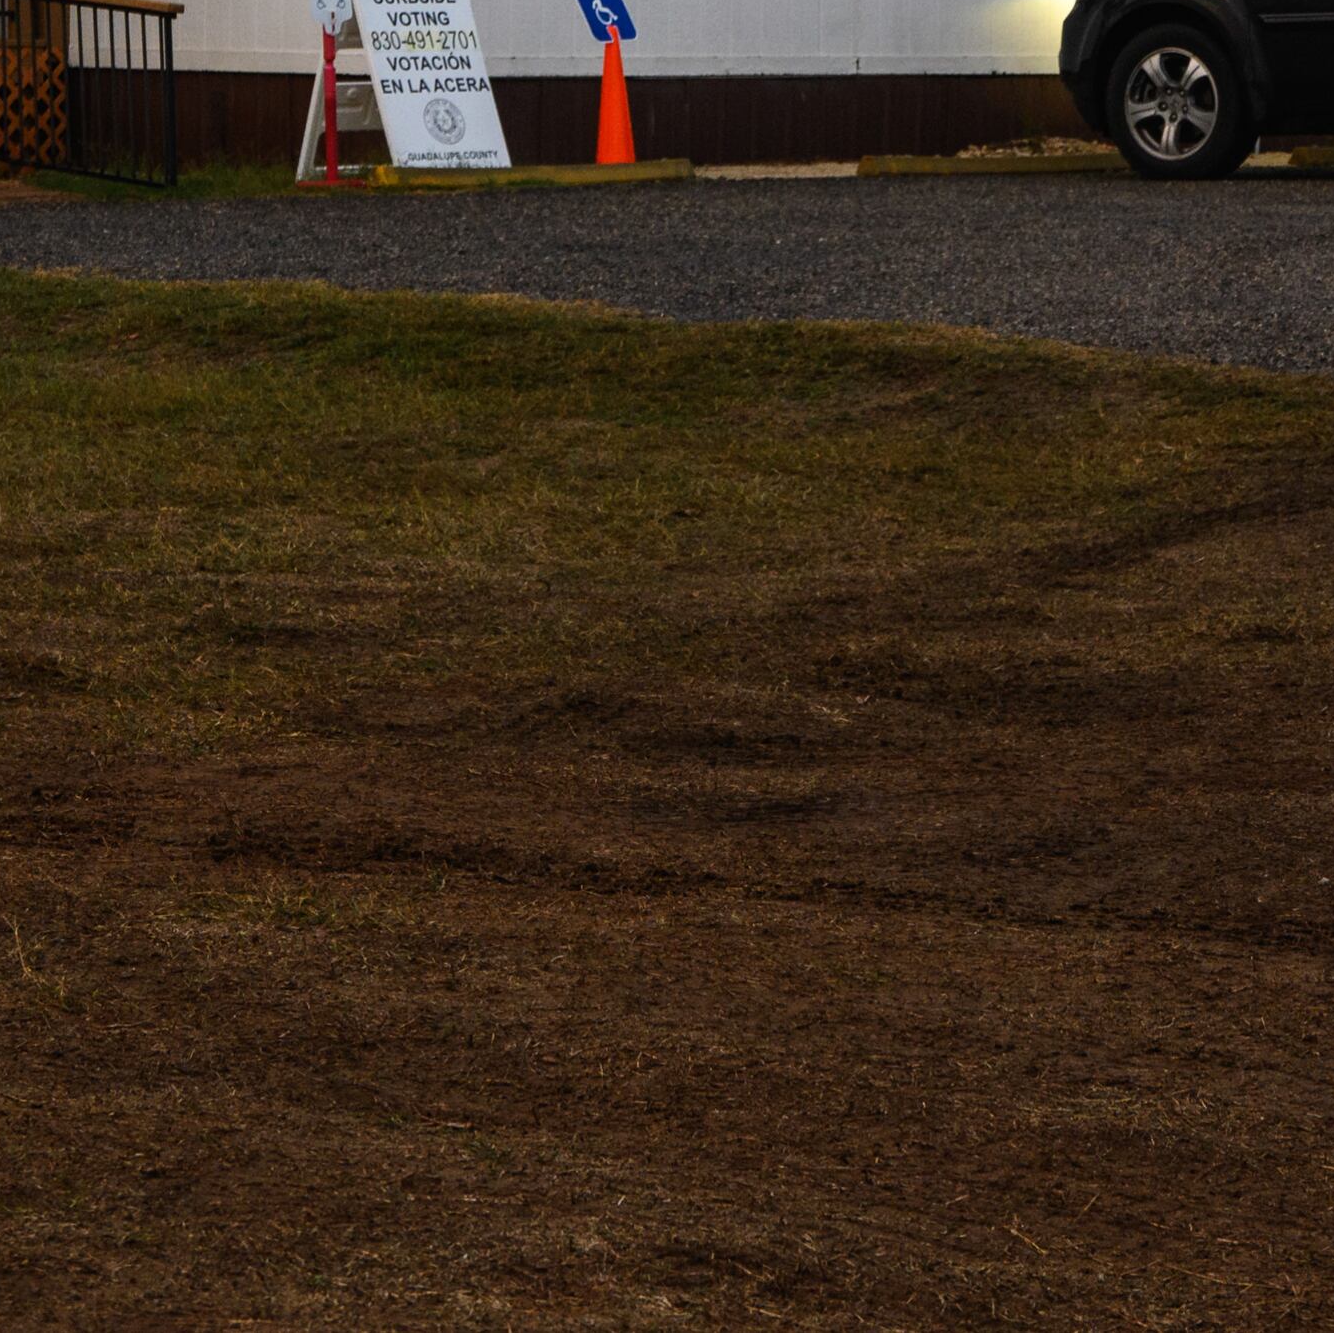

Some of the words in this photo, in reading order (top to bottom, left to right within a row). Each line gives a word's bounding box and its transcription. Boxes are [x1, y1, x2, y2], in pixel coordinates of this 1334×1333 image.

[387, 11, 450, 27] VOTING
[371, 30, 477, 51] 830-491-2701
[387, 52, 471, 72] VOTACIÓN
[381, 79, 404, 95] EN
[408, 78, 430, 94] LA
[433, 77, 491, 94] ACERA
